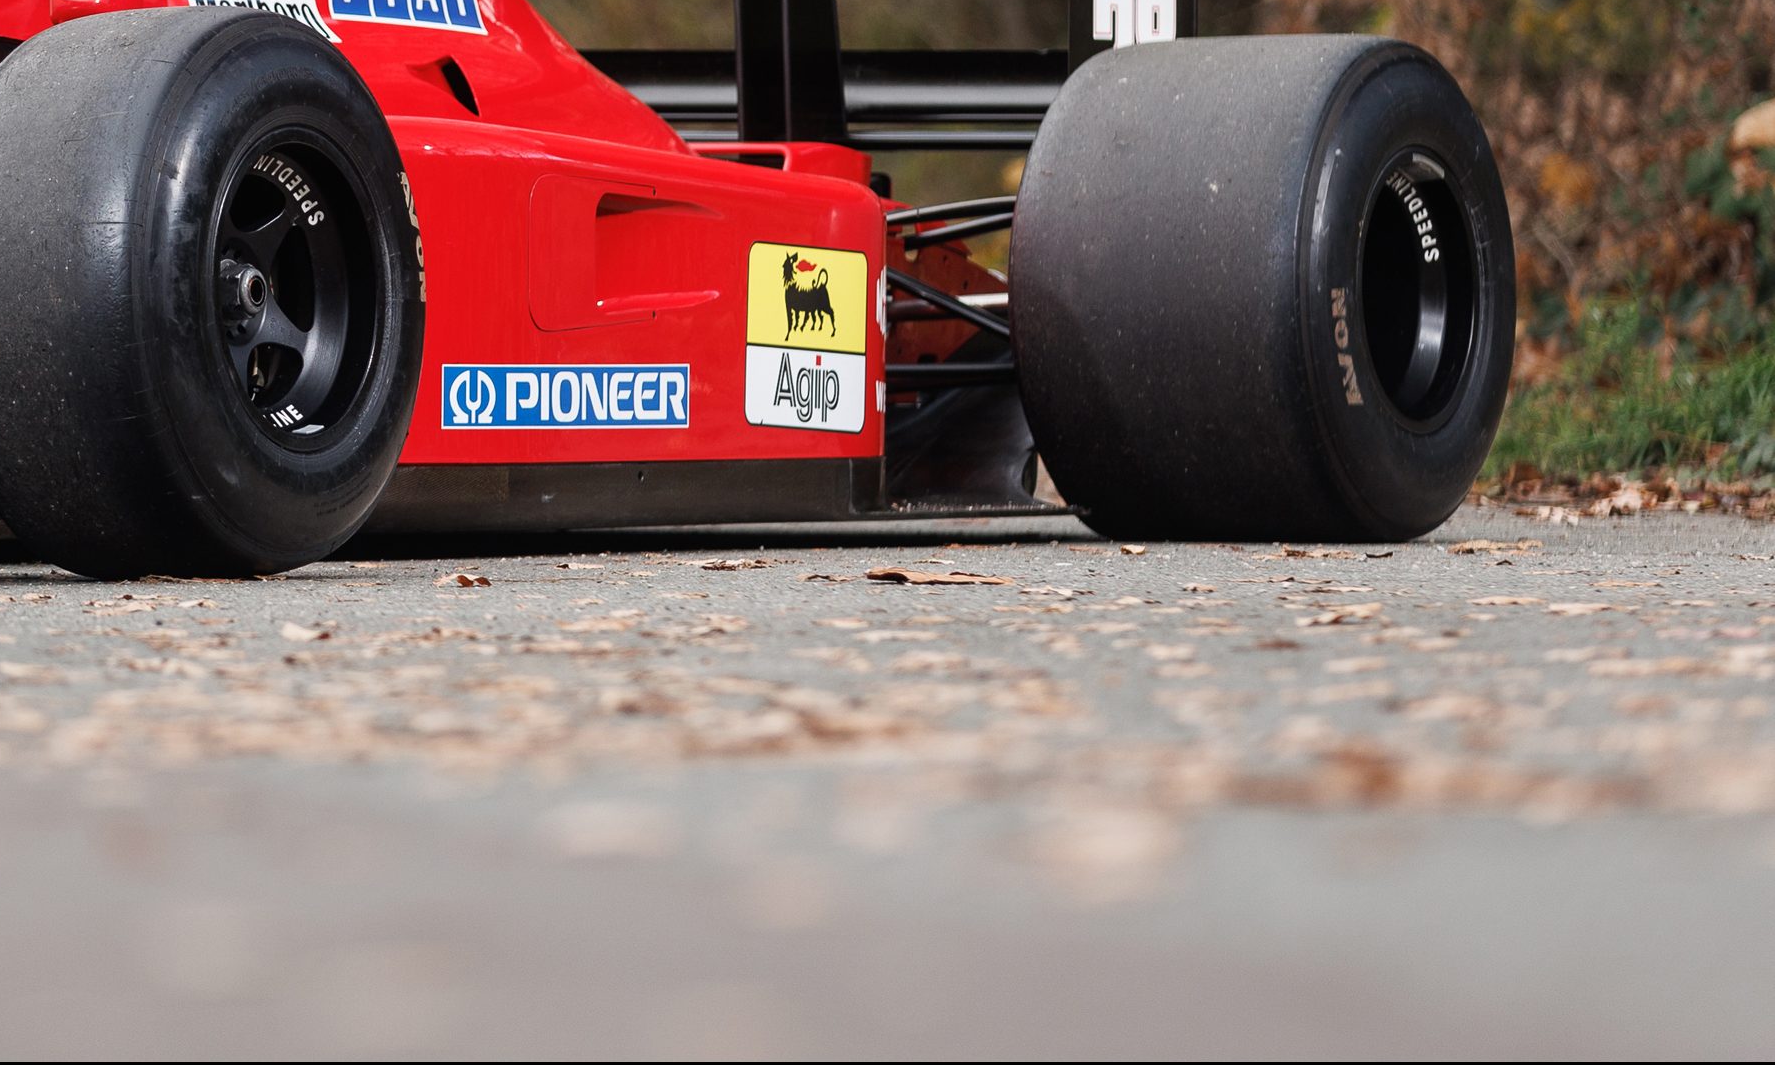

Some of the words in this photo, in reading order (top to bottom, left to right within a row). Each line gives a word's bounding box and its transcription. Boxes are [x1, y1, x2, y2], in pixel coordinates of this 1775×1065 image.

[253, 154, 325, 227] SPEEDLIN
[1385, 171, 1440, 263] SPEEDLINE
[1330, 287, 1364, 406] AVON
[506, 371, 685, 423] PIONEER
[773, 353, 840, 422] Agip
